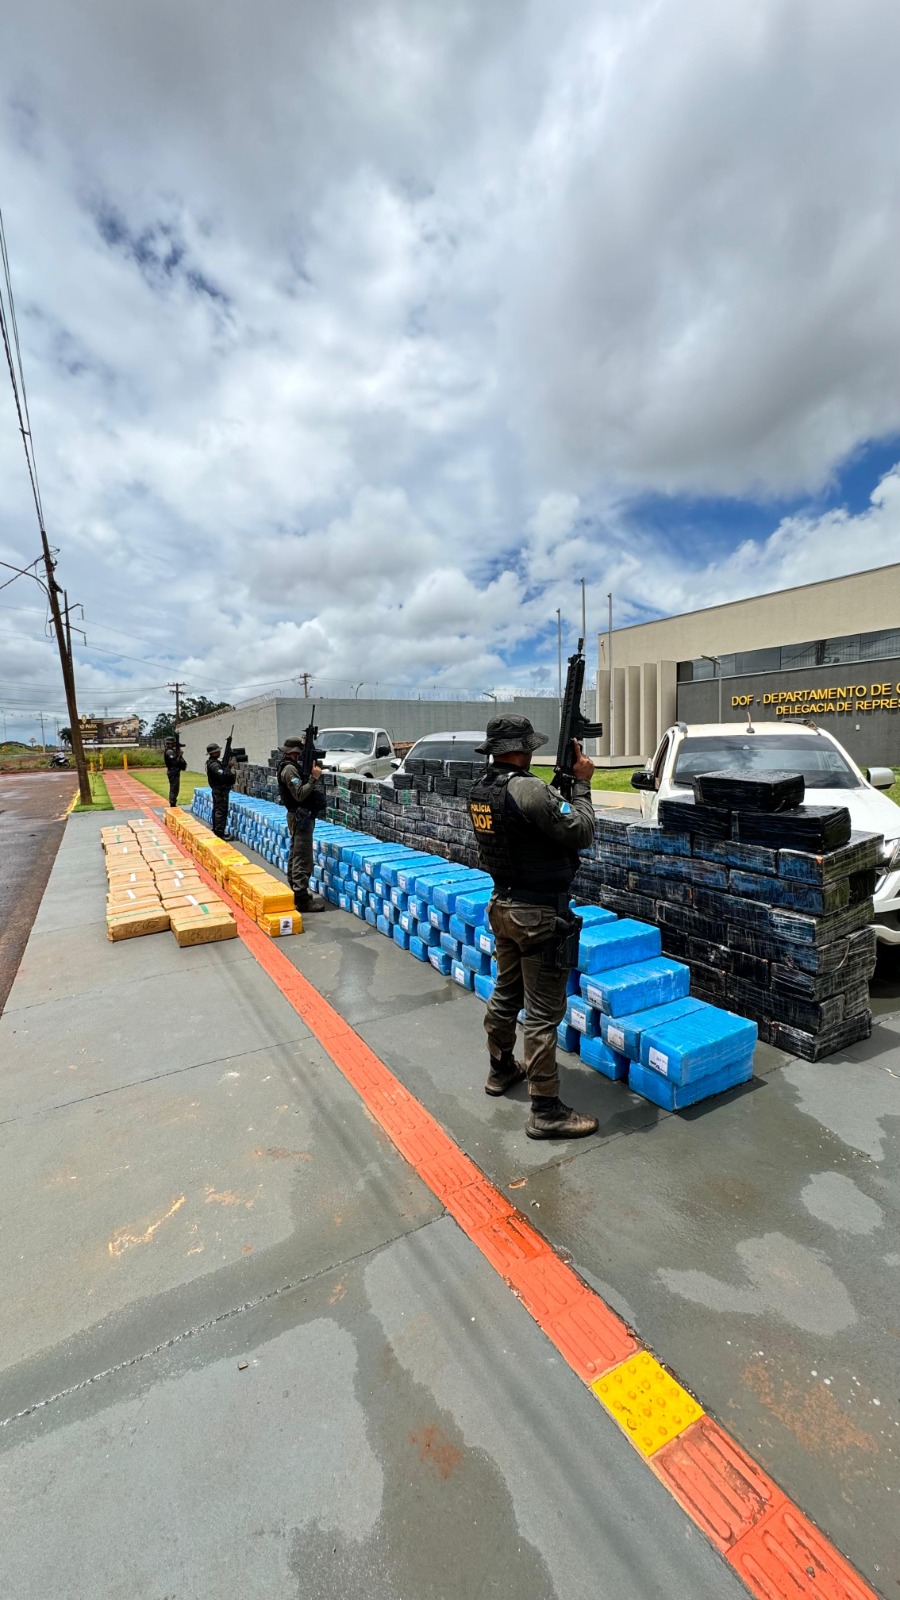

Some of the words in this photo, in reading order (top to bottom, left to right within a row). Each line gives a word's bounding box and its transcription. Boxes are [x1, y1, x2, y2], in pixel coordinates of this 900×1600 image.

[731, 694, 754, 707] DOF
[763, 685, 867, 704] DEPARTAMENTO
[870, 683, 892, 696] DE
[775, 702, 835, 716] DELEGACIA
[836, 701, 853, 712] DE
[855, 698, 900, 710] REPRE
[470, 803, 491, 813] POLÍCIA
[472, 813, 493, 829] DOF
